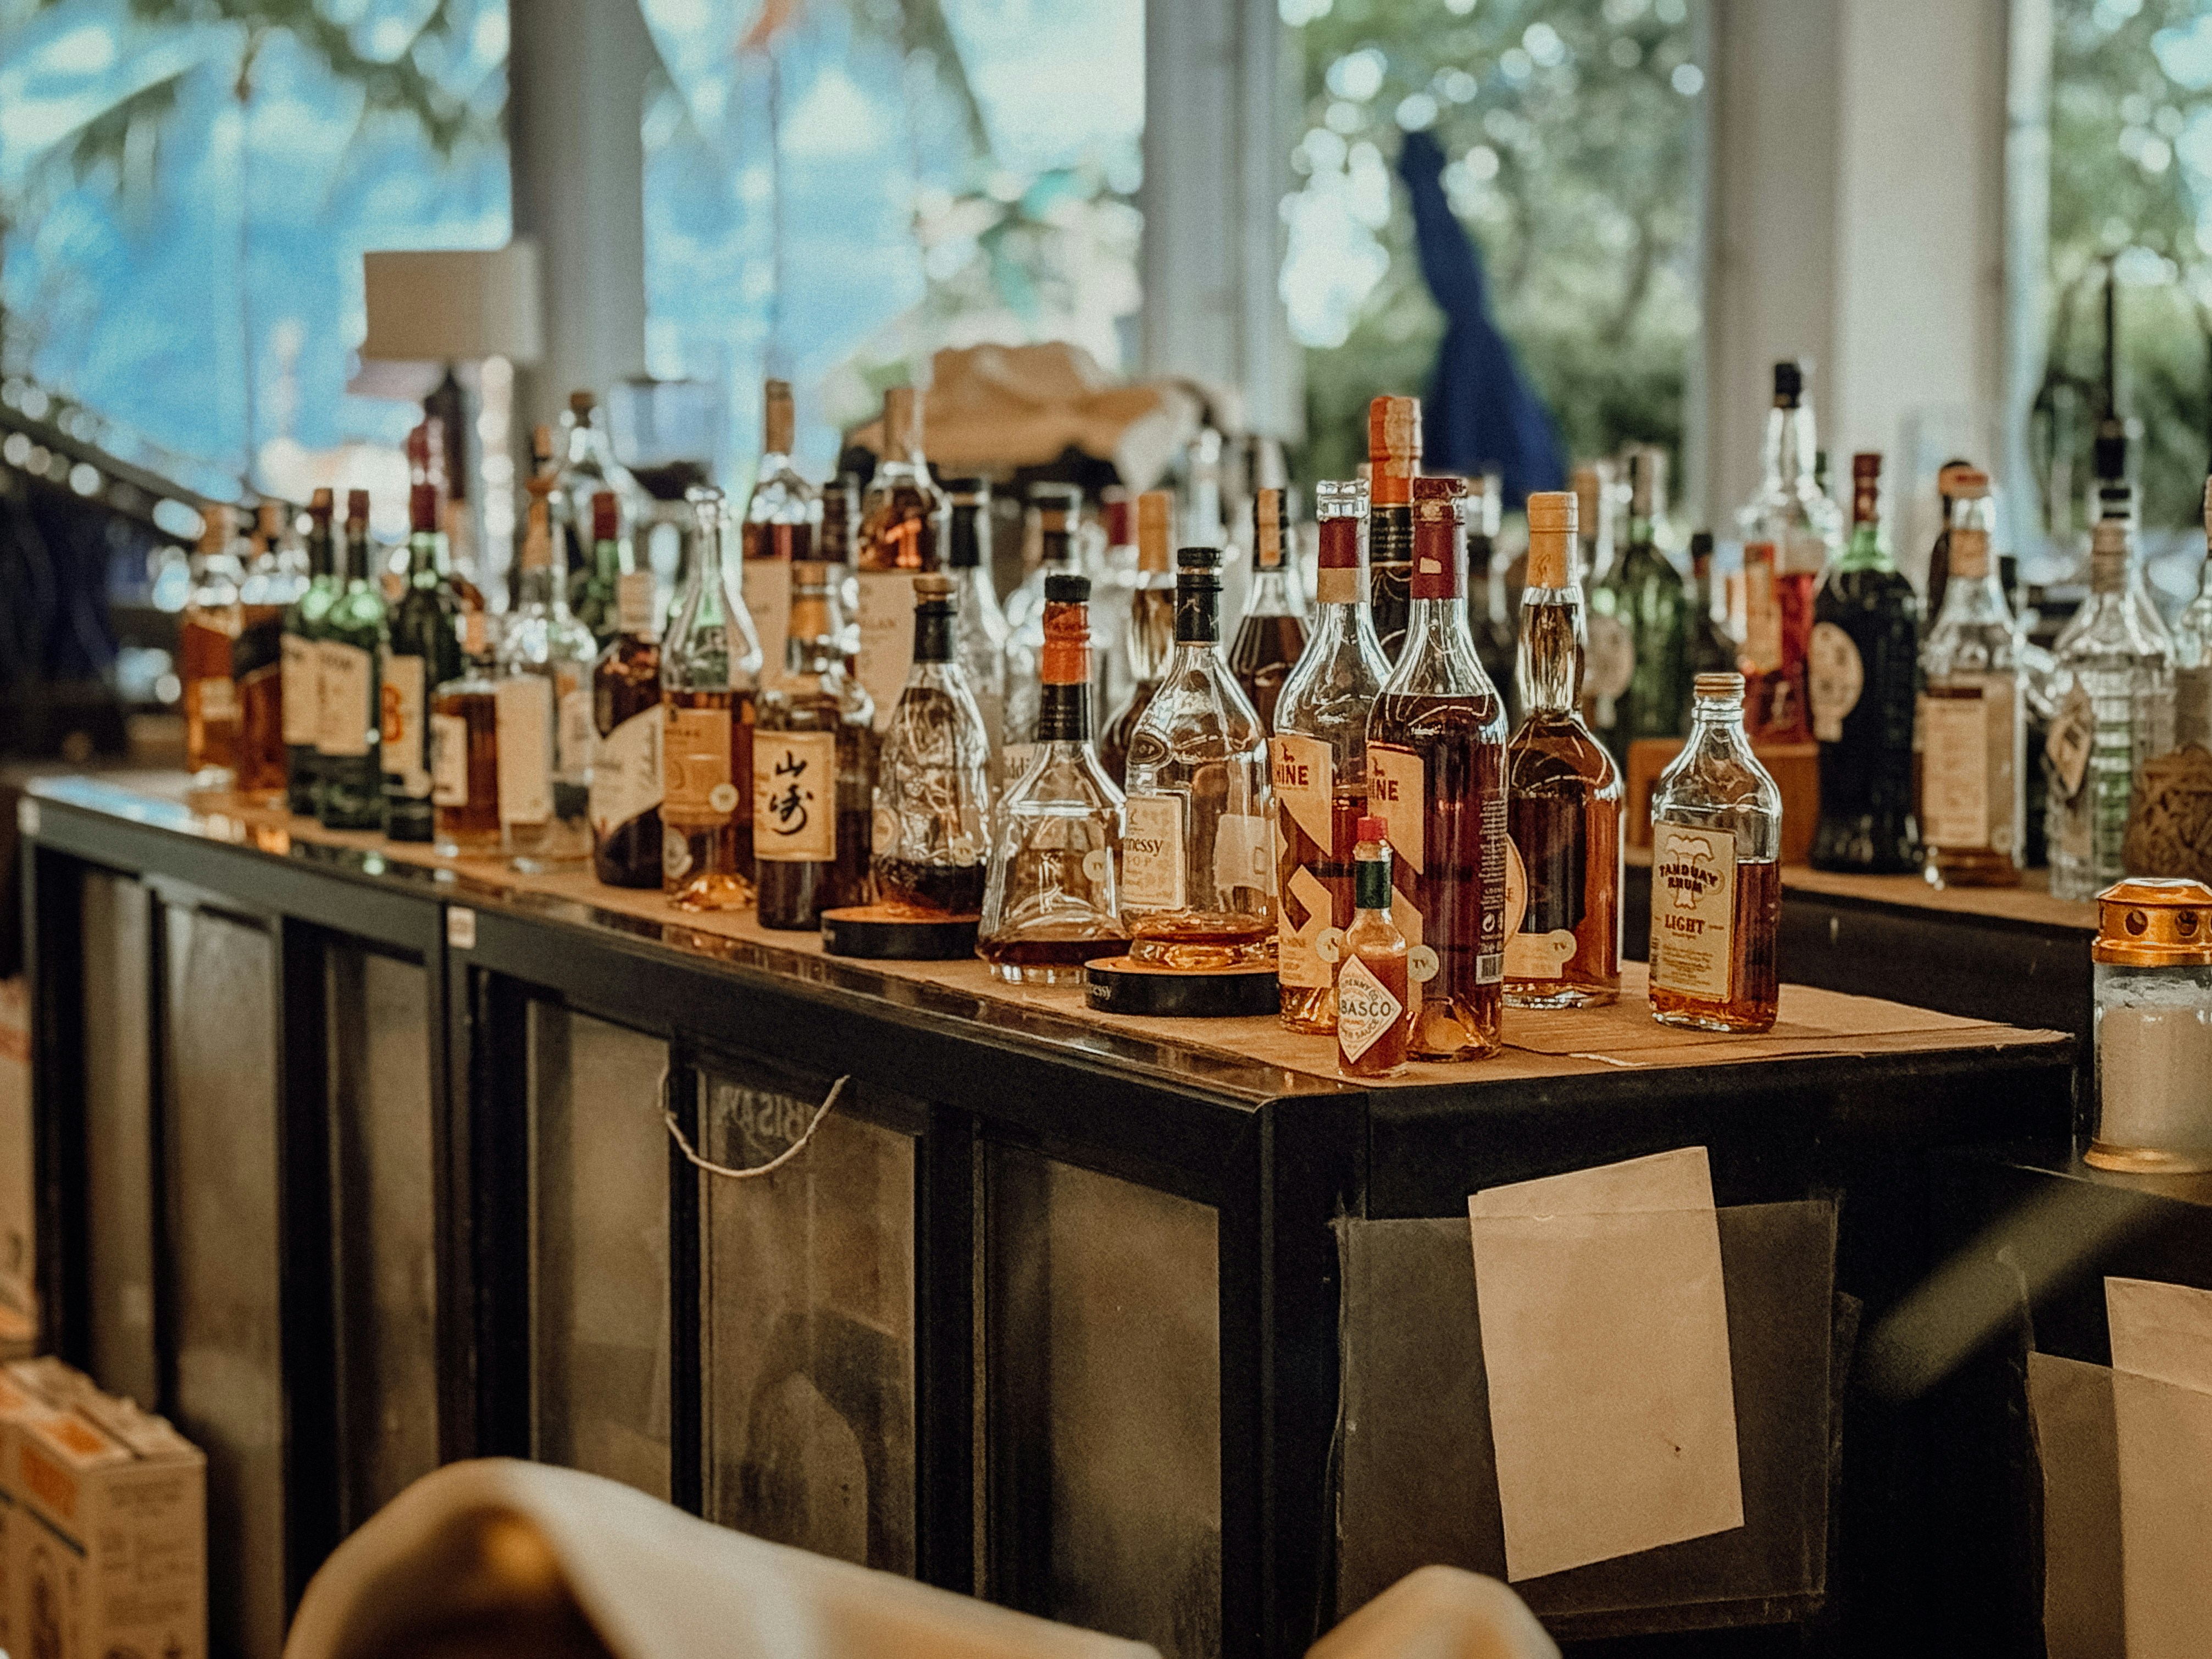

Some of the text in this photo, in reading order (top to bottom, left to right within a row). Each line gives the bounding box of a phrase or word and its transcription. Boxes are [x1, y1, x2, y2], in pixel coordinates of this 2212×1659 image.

[1659, 863, 1719, 887] TANDUAY
[1667, 876, 1703, 895] RHUM
[1664, 913, 1706, 935] LIGHT
